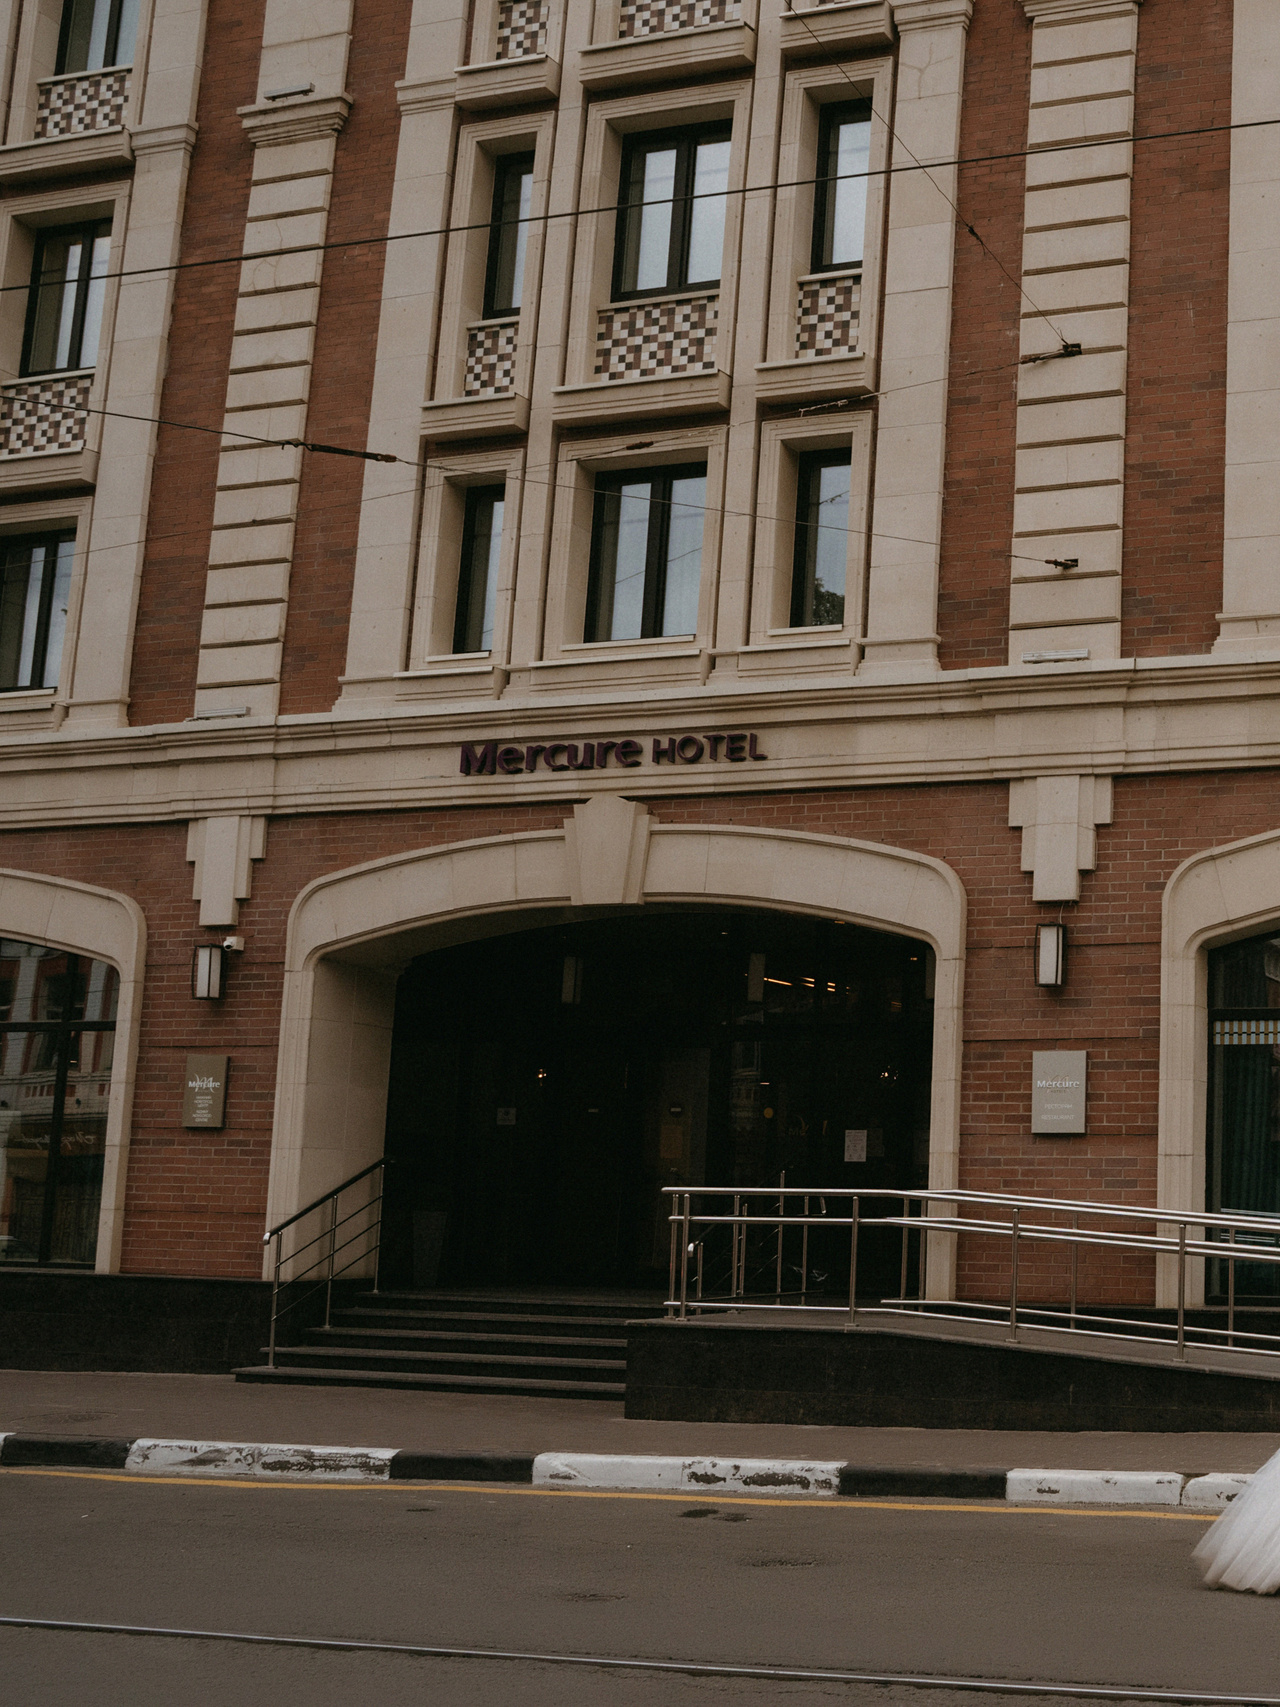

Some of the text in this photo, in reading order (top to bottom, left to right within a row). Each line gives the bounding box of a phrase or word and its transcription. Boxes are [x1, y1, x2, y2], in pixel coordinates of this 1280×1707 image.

[459, 732, 768, 775] Mercure HOTEL
[188, 1080, 221, 1088] Mercure
[1037, 1080, 1080, 1088] Mercure
